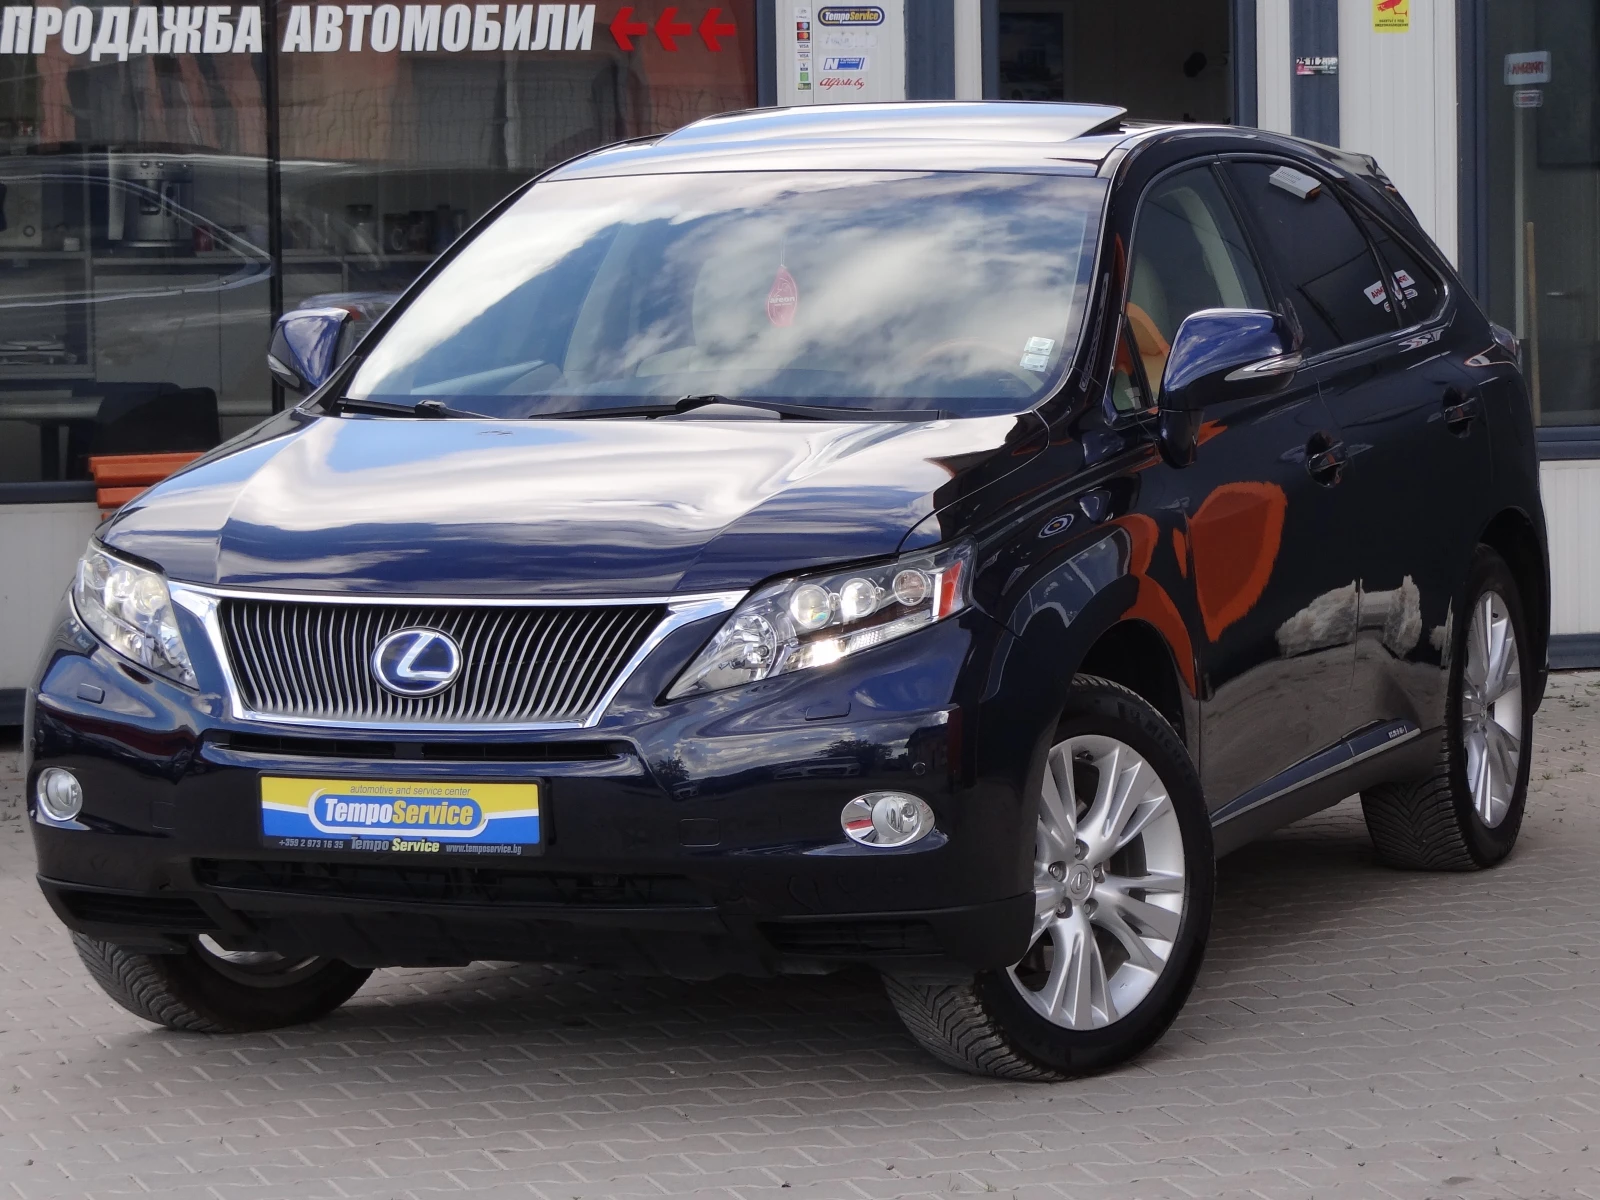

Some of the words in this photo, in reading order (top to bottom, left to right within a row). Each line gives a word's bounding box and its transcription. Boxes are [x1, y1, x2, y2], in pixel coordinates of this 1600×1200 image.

[825, 11, 879, 24] TempoService
[0, 6, 262, 61] ПРОДАЖБА
[281, 4, 596, 52] АВТОМОБИЛИ
[350, 785, 393, 794] automotive
[396, 786, 410, 795] and
[413, 786, 442, 795] service
[445, 787, 471, 796] center
[325, 798, 473, 826] TempoService
[279, 838, 299, 847] +359
[300, 839, 306, 847] 2
[307, 839, 321, 848] 973
[323, 840, 332, 848] 16
[334, 840, 344, 849] 35
[351, 837, 389, 852] Tempo
[391, 838, 440, 853] Service
[446, 844, 522, 855] www.temposervice.bg
